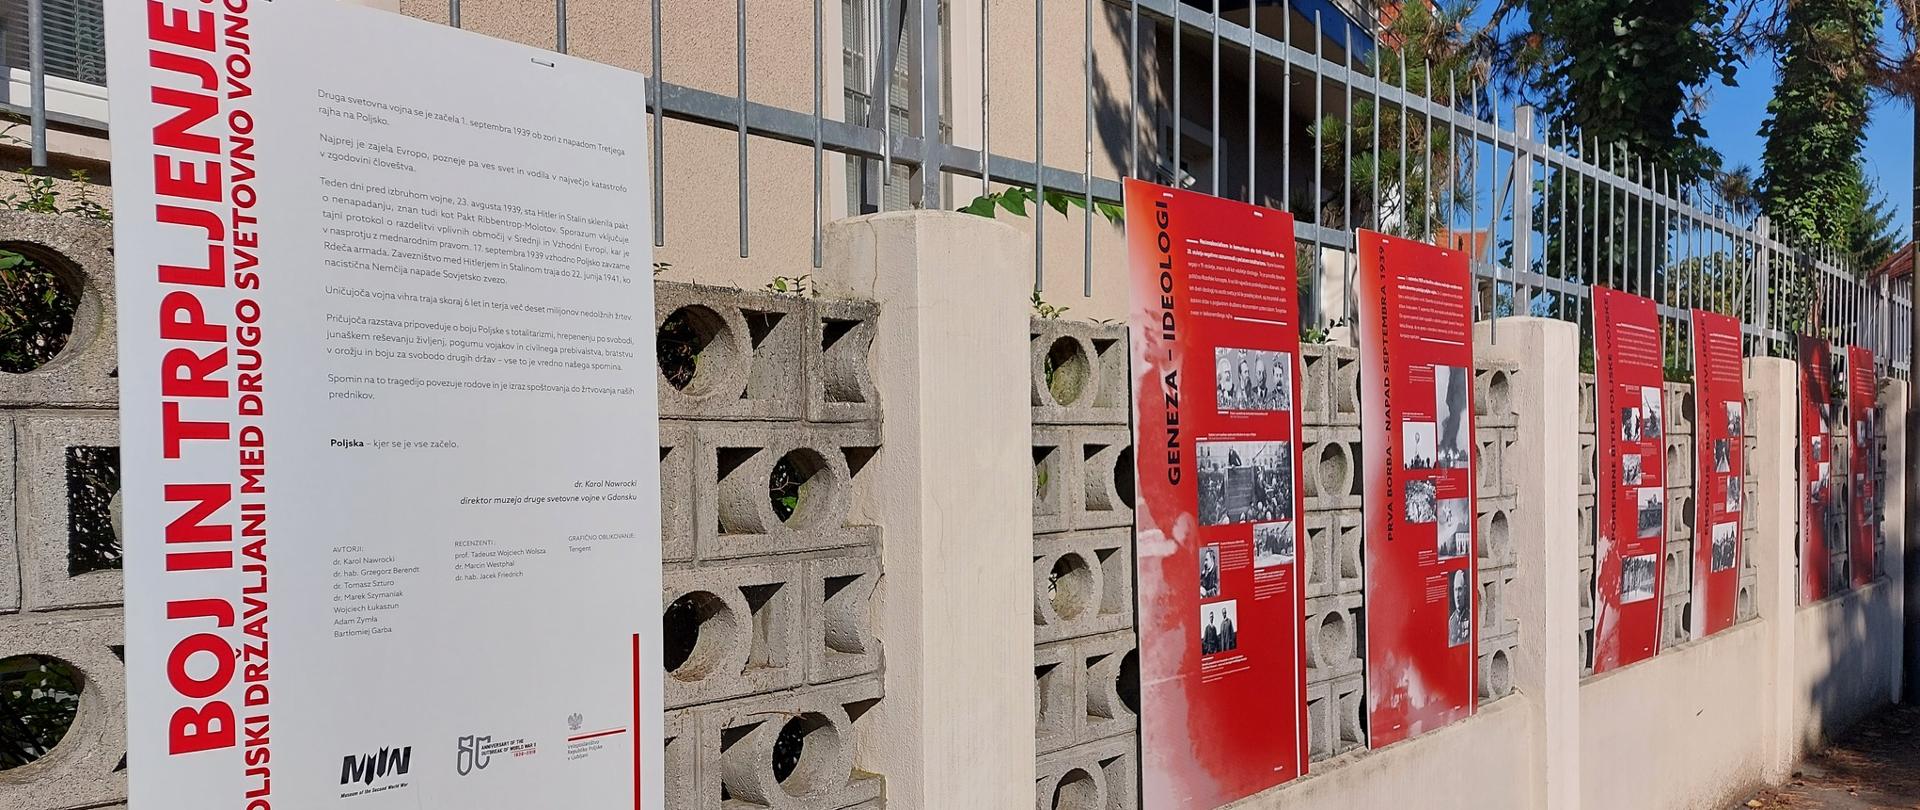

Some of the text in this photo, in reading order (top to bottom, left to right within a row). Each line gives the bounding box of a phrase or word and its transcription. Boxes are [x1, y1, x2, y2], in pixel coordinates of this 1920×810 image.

[317, 88, 556, 142] Druga svetovna vojna začela septembra 1939 zori
[318, 106, 340, 117] rajha
[319, 132, 354, 148] Najprej
[368, 142, 394, 154] zajela
[432, 153, 466, 167] pozneje
[497, 165, 514, 174] svet
[526, 170, 550, 180] vodila
[558, 175, 590, 187] največjo
[327, 152, 371, 165] zgodovini
[228, 109, 260, 290] SVETOVNO
[319, 176, 348, 188] Teden
[365, 185, 386, 194] pred
[387, 187, 428, 200] izbruhom
[470, 200, 502, 211] avgusta
[537, 209, 557, 219] Hitler
[566, 213, 587, 224] Stalin
[397, 205, 418, 214] znan
[420, 207, 438, 217] tudi
[456, 211, 475, 222] Pakt
[322, 210, 583, 251] tajni protokol razdelitvi vplivnih območij Srednji Vzhodni
[329, 228, 371, 240] nasprotju
[379, 233, 438, 246] mednarodnim
[484, 246, 526, 258] septembra
[527, 248, 544, 260] 1939
[544, 252, 575, 264] vzhodno
[323, 240, 352, 252] Rdeča
[391, 248, 442, 262] Zavezništvo
[462, 257, 500, 269] Hitlerjem
[509, 262, 543, 274] Stalinom
[543, 267, 560, 278] traja
[324, 259, 370, 270] nacistična
[372, 261, 408, 276] Nemčija
[409, 268, 441, 279] napade
[442, 269, 482, 282] Sovjetsko
[1156, 201, 1176, 341] IDEOLOGI
[325, 285, 370, 298] Uničujoča
[371, 290, 396, 301] vojna
[397, 292, 418, 302] vihra
[419, 295, 438, 305] traja
[439, 295, 463, 308] skoraj
[491, 301, 509, 311] terja
[524, 304, 545, 314] deset
[326, 313, 367, 326] Pričujoča
[368, 318, 403, 327] razstava
[403, 319, 451, 333] pripoveduje
[459, 322, 477, 334] boju
[478, 324, 504, 336] Poljske
[326, 330, 370, 340] junaškem
[372, 333, 414, 345] reševanju
[449, 339, 484, 349] pogumu
[485, 340, 515, 351] vojakov
[525, 343, 558, 355] civilnega
[1380, 285, 1390, 373] SEPTEMBRA
[1604, 298, 1612, 349] VOJSKE
[235, 298, 263, 416] DRUGO
[334, 346, 564, 368] orožju boju svobodo drugih držav vredno
[327, 373, 362, 384] Spomin
[426, 379, 462, 390] povezuje
[463, 380, 491, 389] rodove
[526, 383, 570, 394] spoštovanja
[1607, 354, 1615, 414] POLJSKE
[1165, 369, 1181, 486] GENEZA
[1384, 382, 1392, 432] NAPAD
[239, 425, 265, 494] MED
[330, 438, 364, 449] Poljska
[164, 483, 233, 572] IN
[235, 503, 269, 707] DRŽAVLJANI
[167, 598, 236, 756] BOJ
[481, 741, 509, 750] ANNIVERSARY
[481, 748, 502, 756] OUTBREAK
